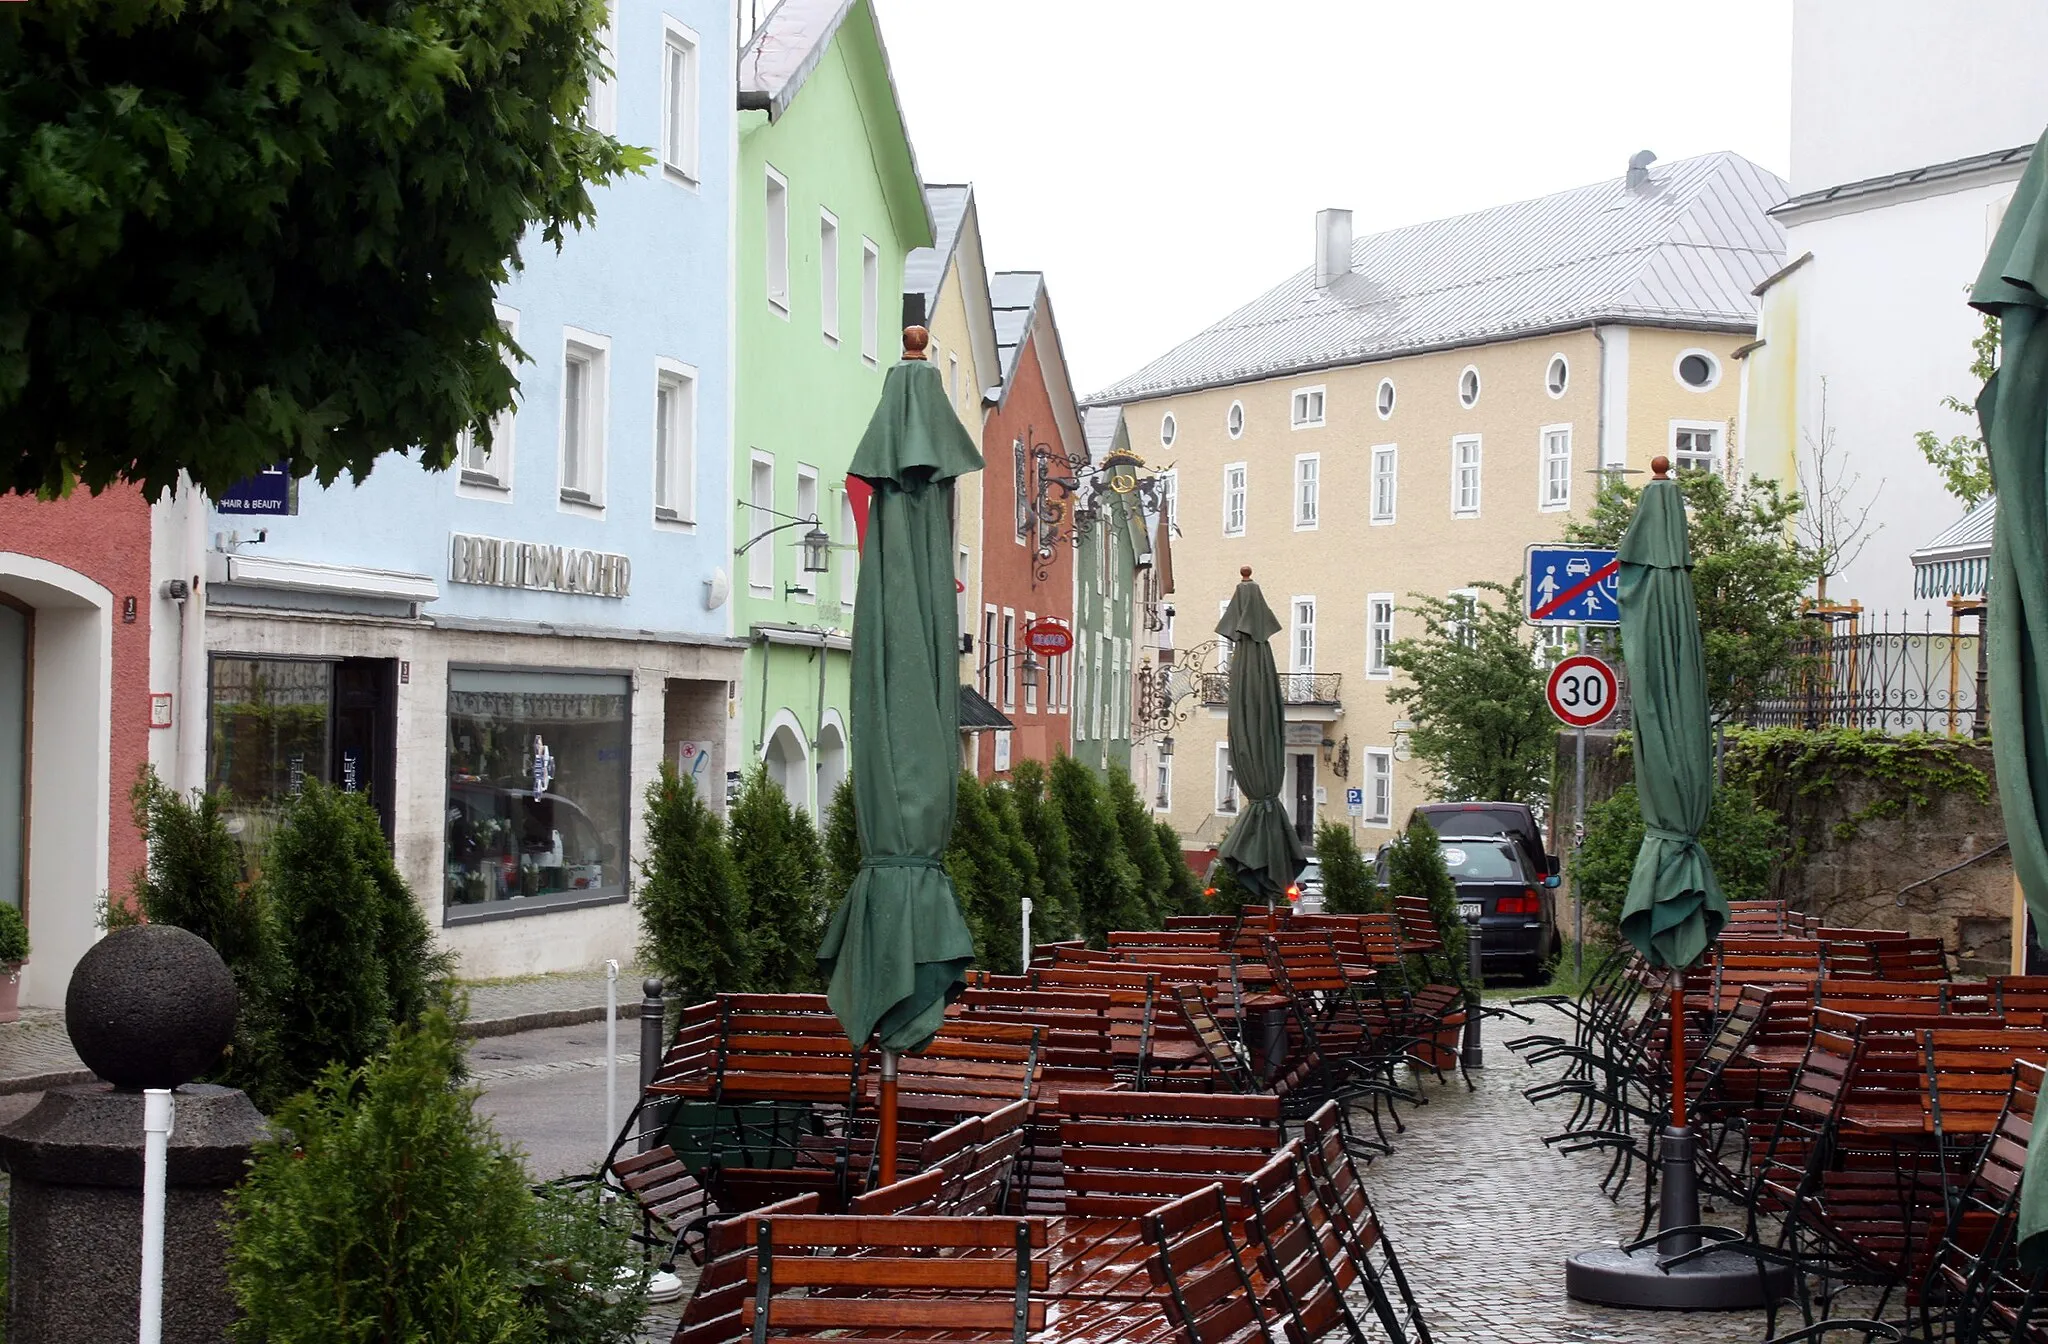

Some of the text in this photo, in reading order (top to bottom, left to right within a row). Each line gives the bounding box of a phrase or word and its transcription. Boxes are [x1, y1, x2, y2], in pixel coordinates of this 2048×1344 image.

[223, 499, 282, 509] HAIR & BEAUTY
[453, 535, 631, 597] BRILLENMACHER
[1561, 675, 1602, 707] 30
[1348, 790, 1358, 803] P
